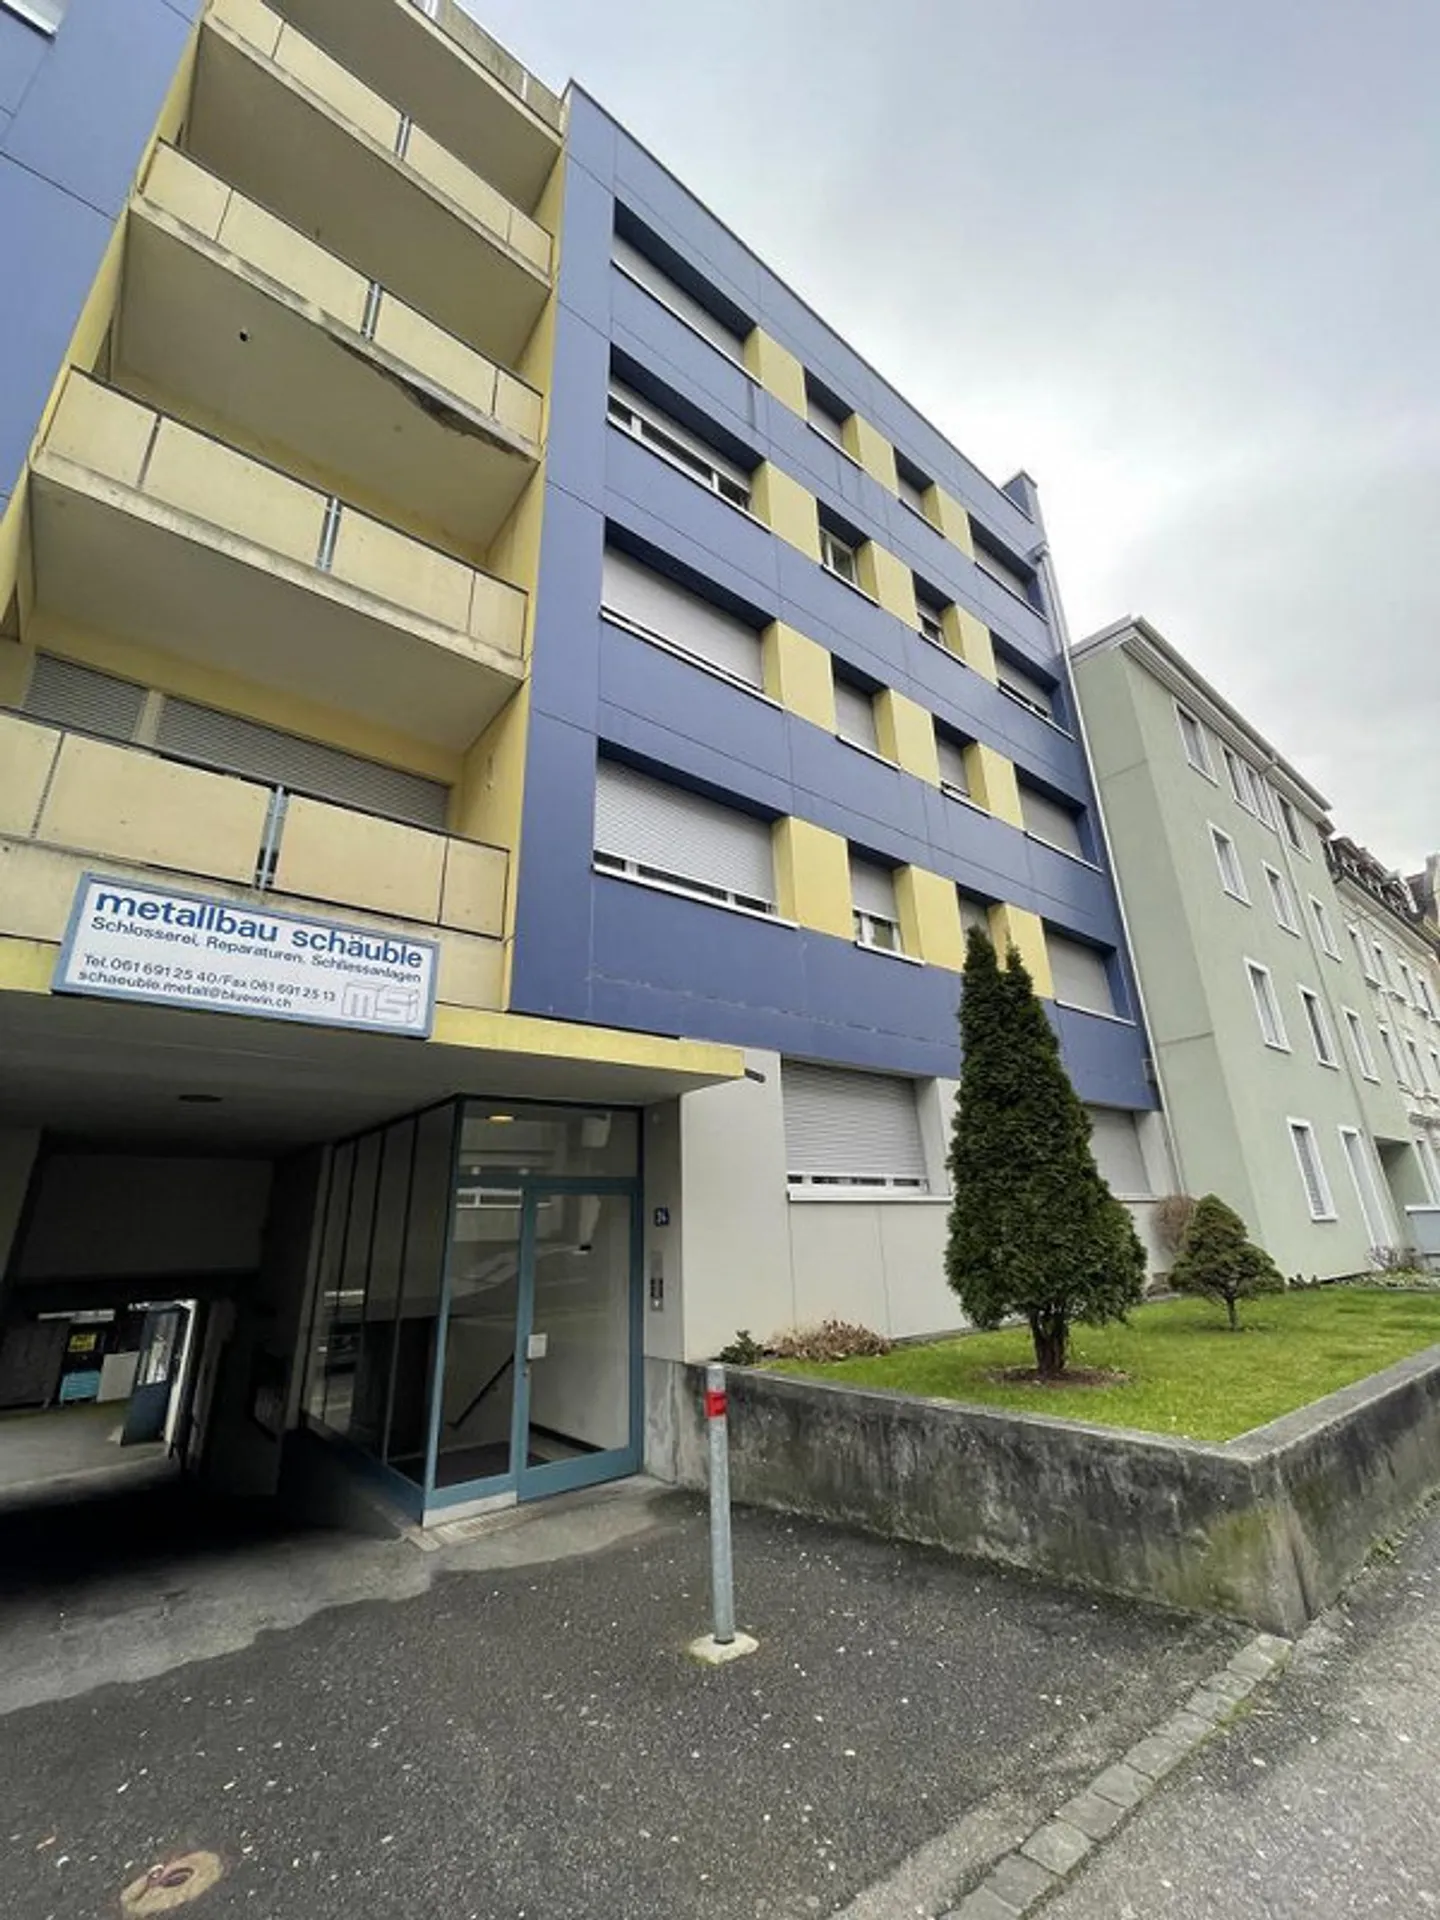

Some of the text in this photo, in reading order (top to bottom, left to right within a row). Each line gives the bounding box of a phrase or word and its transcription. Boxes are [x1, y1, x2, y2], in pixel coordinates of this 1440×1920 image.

[91, 916, 199, 947] Schlosserei,
[311, 954, 421, 984] Schliessanlagen
[95, 892, 423, 969] metallbau schäuble
